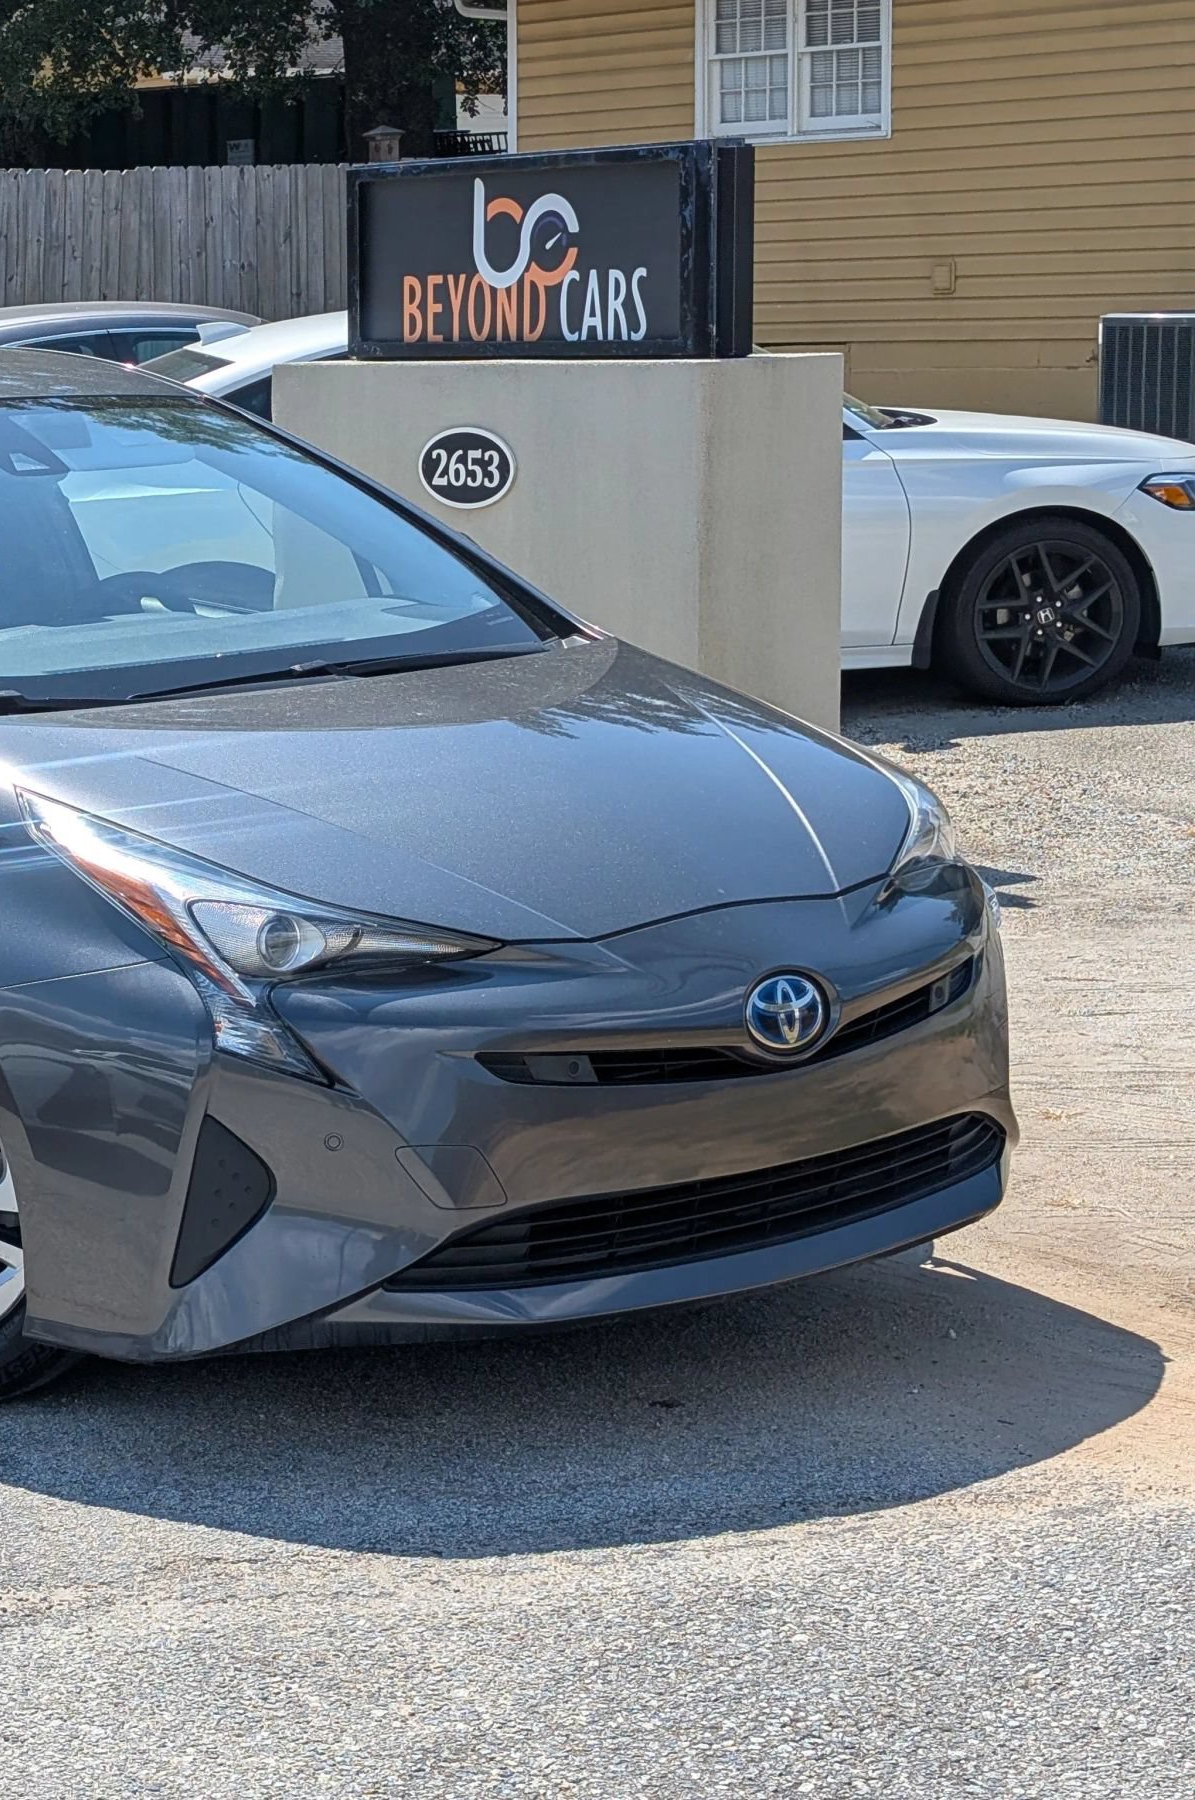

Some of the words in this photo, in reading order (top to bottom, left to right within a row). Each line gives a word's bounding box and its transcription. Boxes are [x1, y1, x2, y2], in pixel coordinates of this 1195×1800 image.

[403, 274, 547, 343] BEYOND
[560, 267, 648, 342] CARS
[431, 448, 501, 488] 2653
